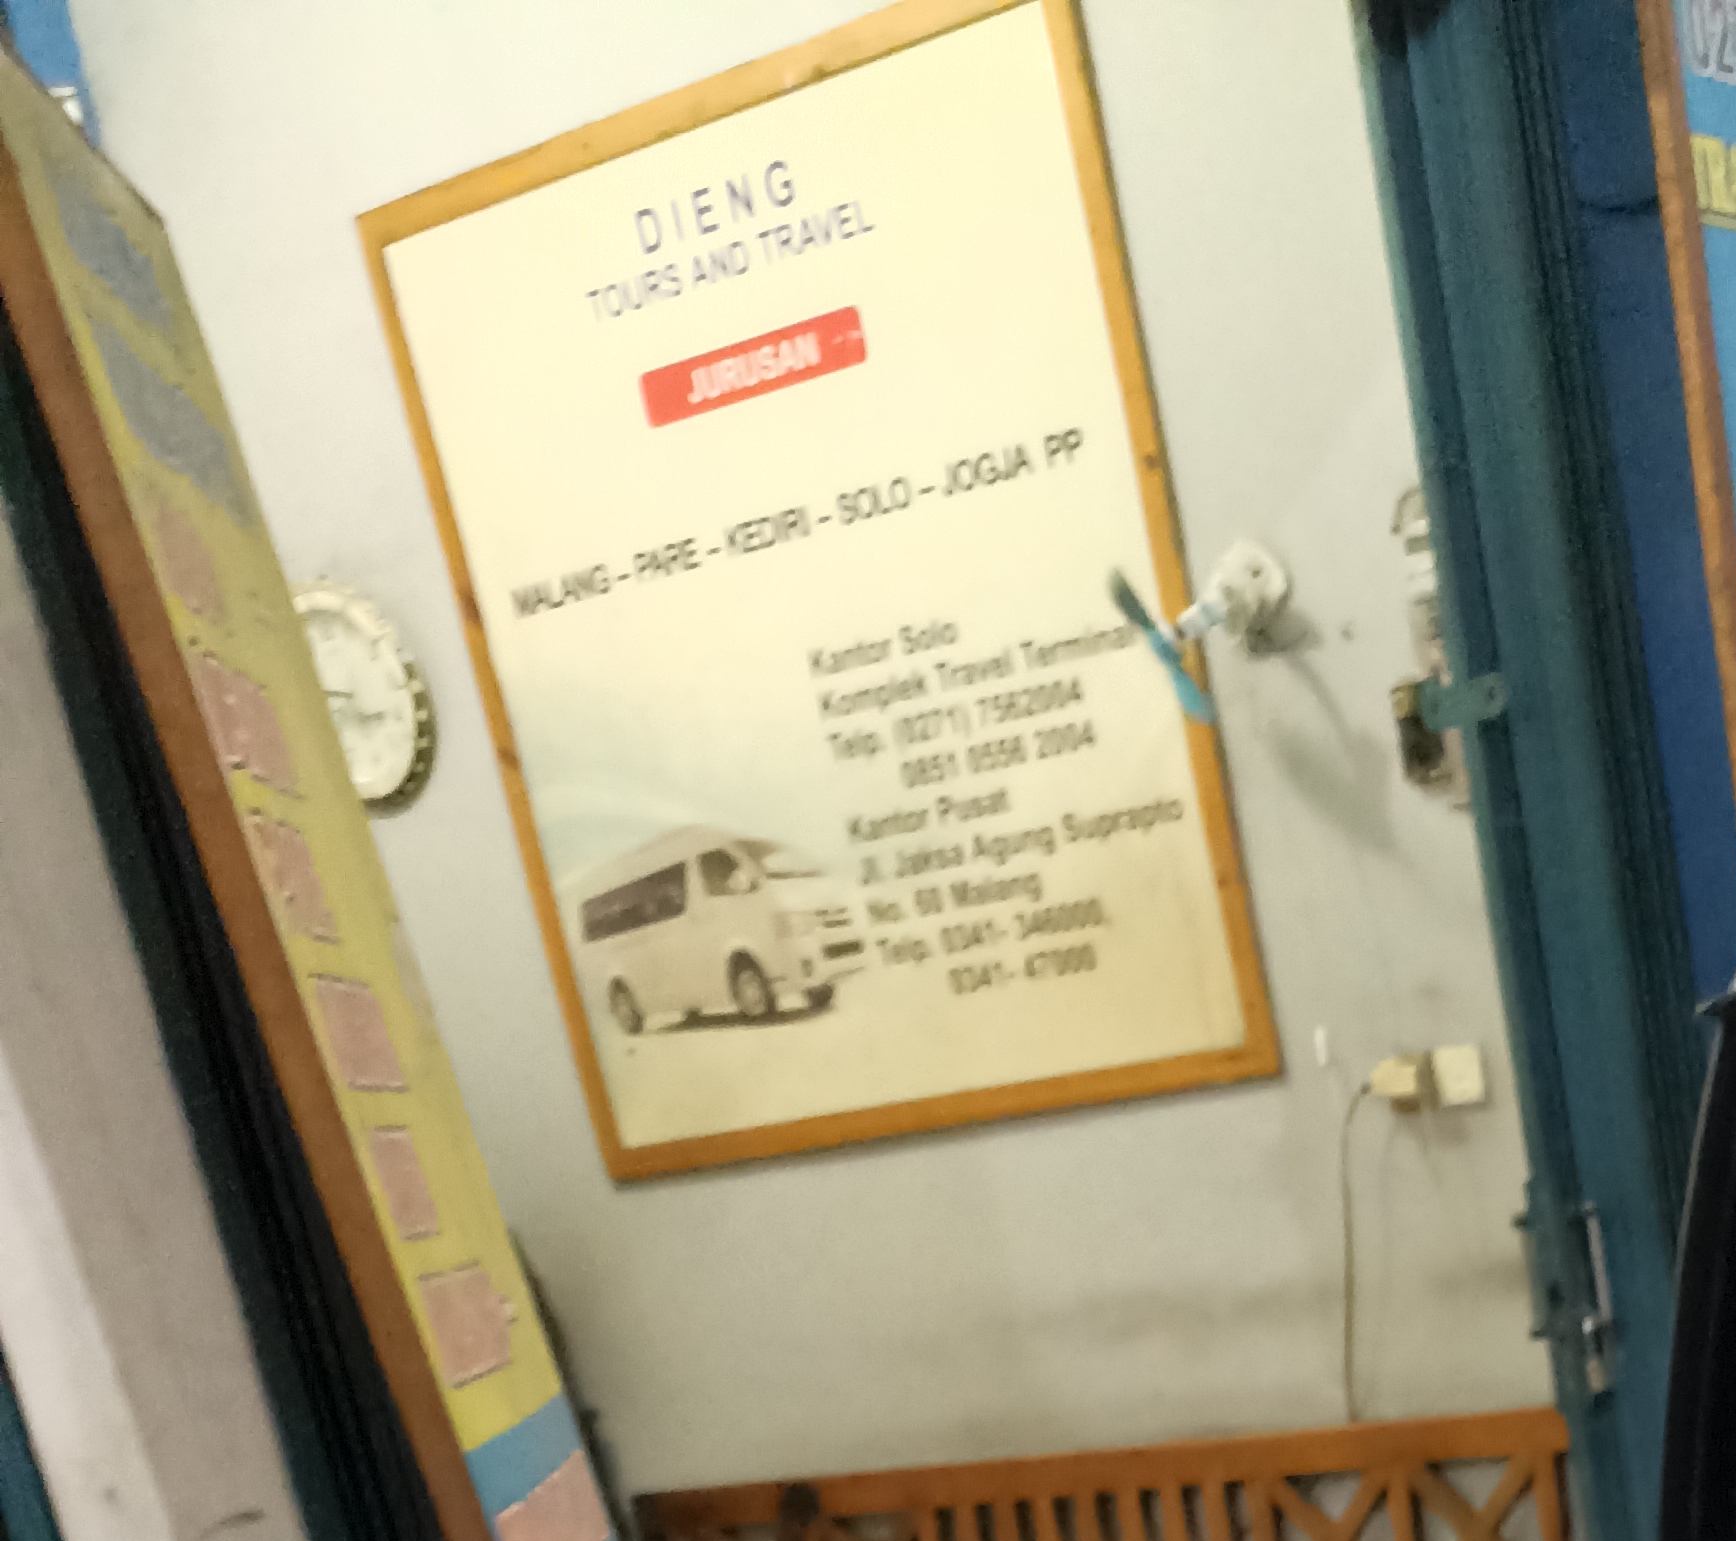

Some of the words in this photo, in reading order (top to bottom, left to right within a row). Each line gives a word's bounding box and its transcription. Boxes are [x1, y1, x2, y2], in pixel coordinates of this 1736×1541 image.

[634, 158, 797, 256] DIENG
[586, 266, 682, 322] TOURS
[690, 240, 753, 293] AND
[757, 199, 877, 267] TRAVEL
[687, 333, 822, 406] JURUSAN
[510, 564, 611, 620] MALANG
[633, 537, 702, 583] PARE
[722, 505, 811, 557] KEDIRI
[836, 475, 912, 527] SOLO
[941, 443, 1032, 500] JOGJA
[1043, 427, 1086, 470] PP
[898, 617, 960, 659] Solo
